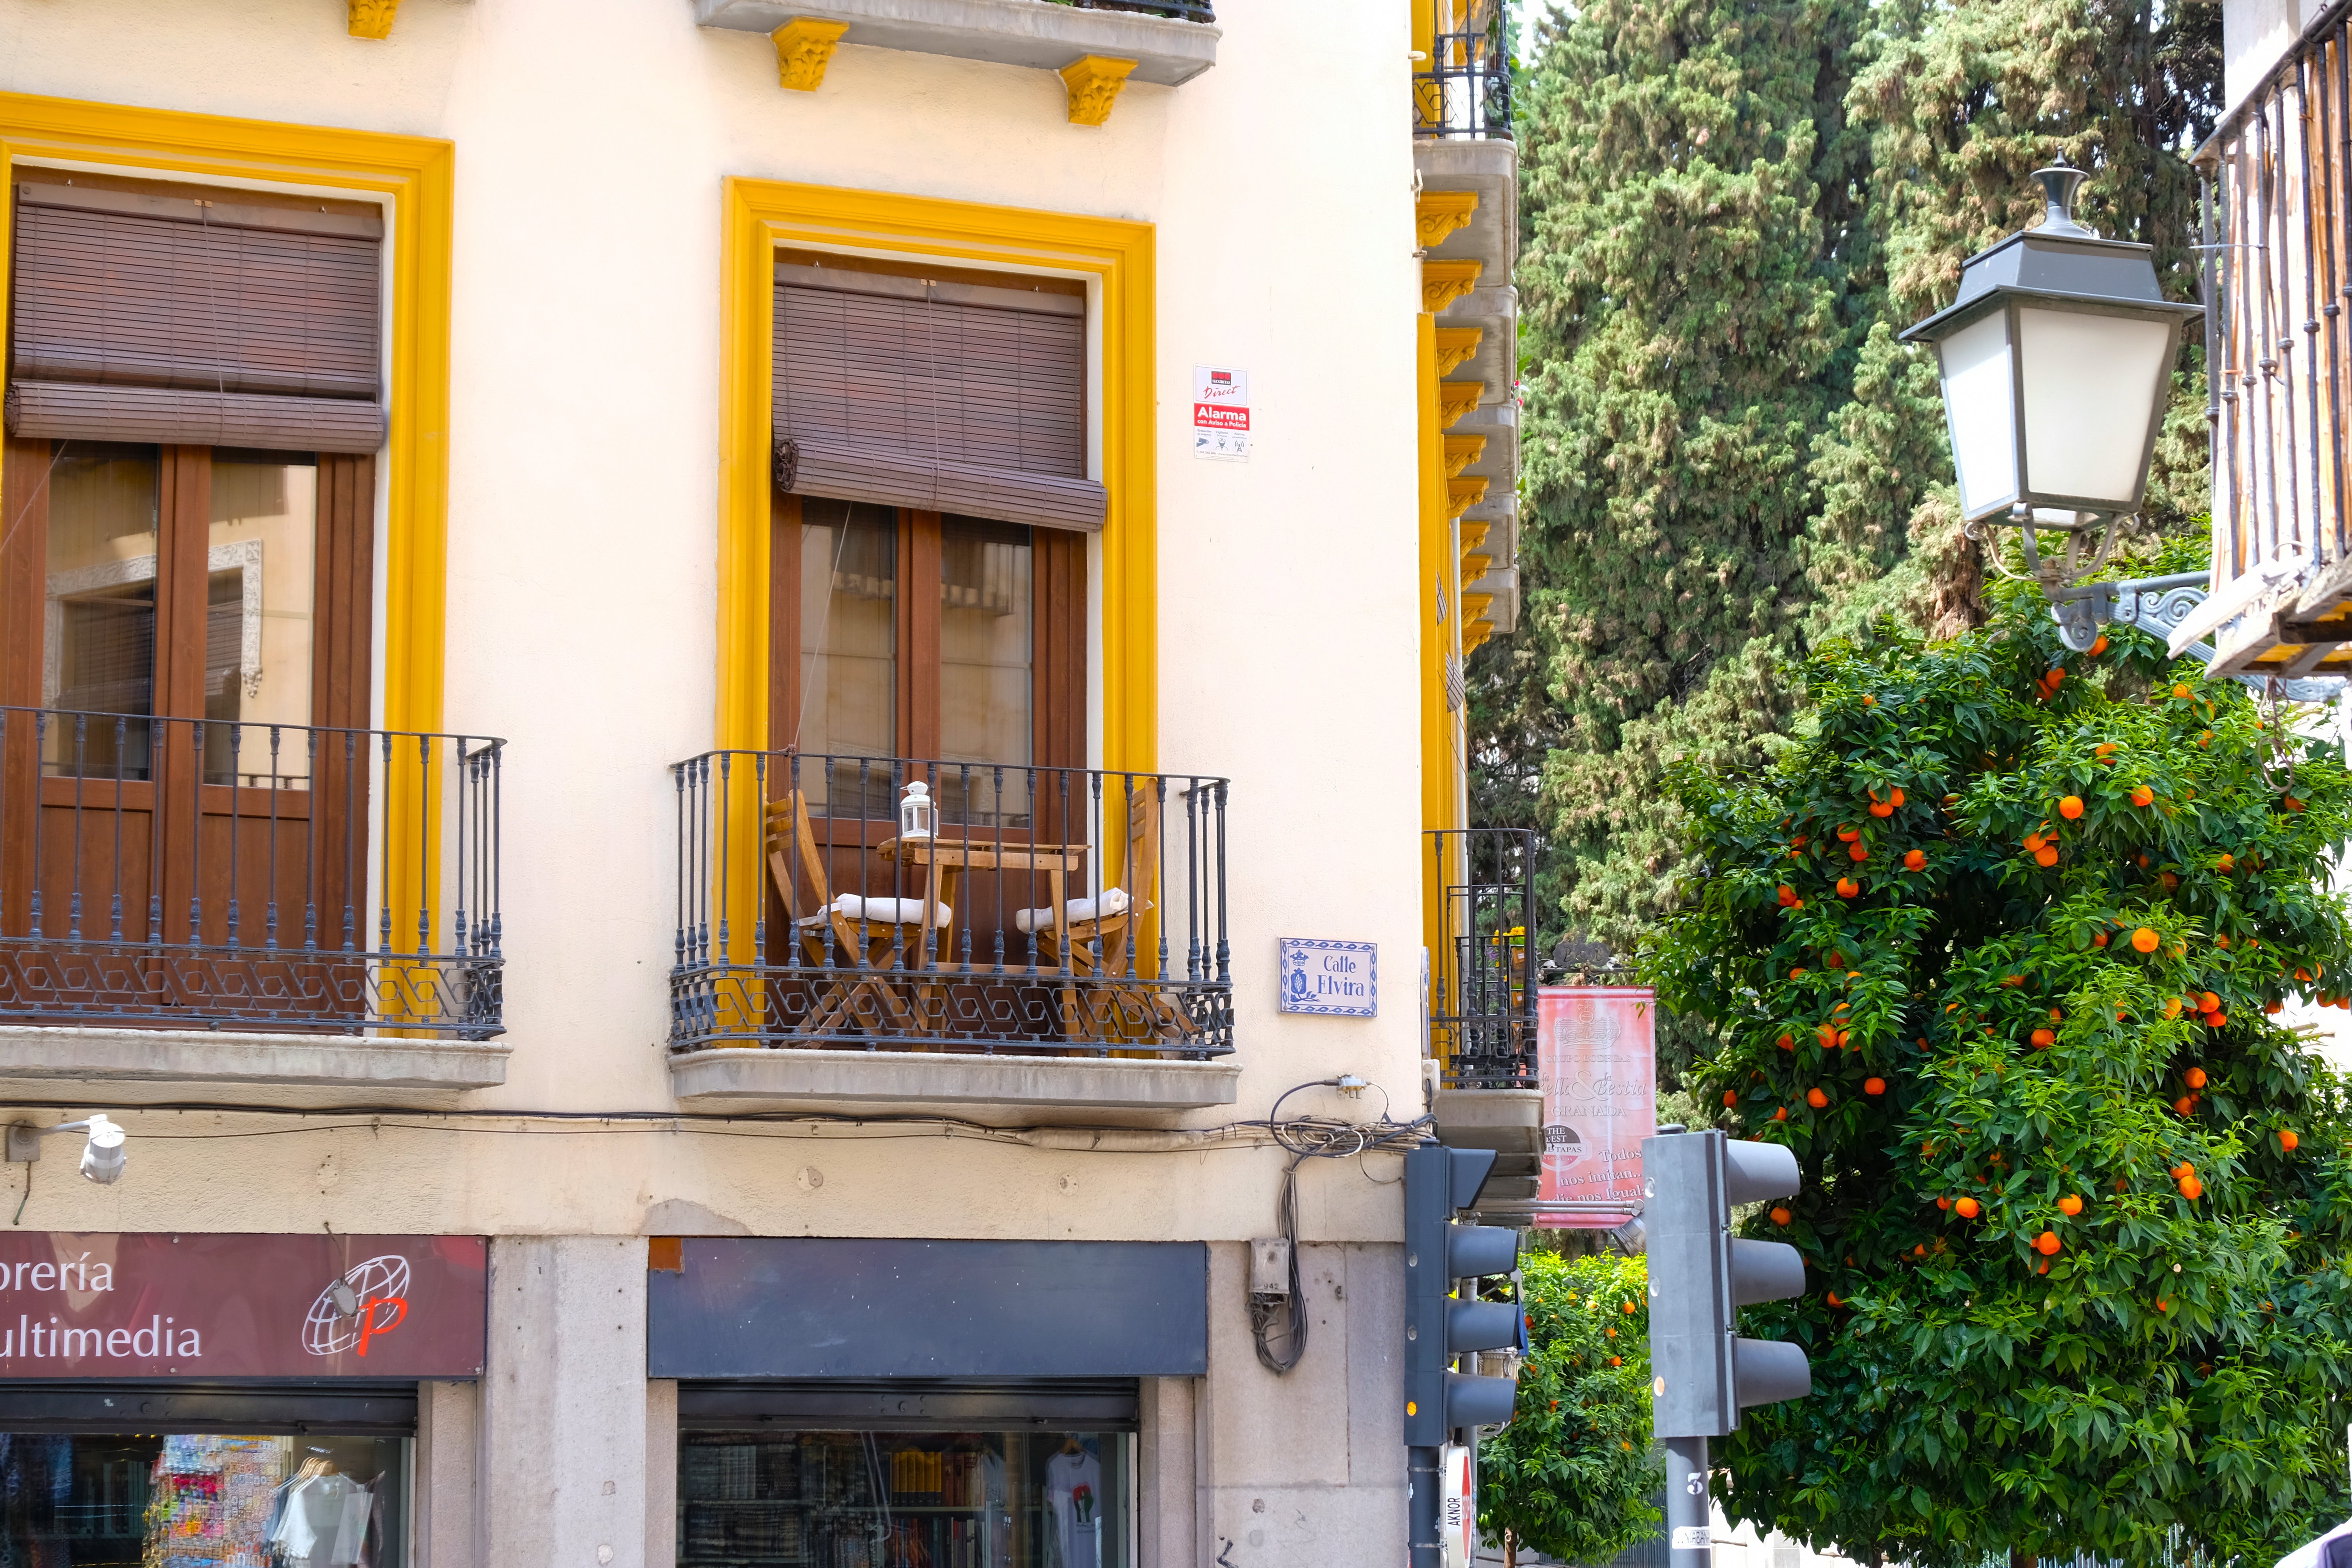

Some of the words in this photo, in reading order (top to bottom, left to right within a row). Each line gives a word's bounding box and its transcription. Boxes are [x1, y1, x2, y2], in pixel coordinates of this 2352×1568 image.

[1203, 385, 1241, 399] Direct
[1197, 406, 1246, 421] Alarma
[1324, 955, 1356, 973] Calle
[1317, 974, 1364, 996] Elvira
[1546, 1055, 1580, 1063] GRUPO
[1583, 1055, 1631, 1063] BODEGAS
[1542, 1072, 1549, 1082] la
[1604, 1072, 1612, 1082] la
[1593, 1079, 1646, 1096] Bestia
[1551, 1105, 1627, 1117] GRANADA
[1598, 1148, 1642, 1162] Todos
[1560, 1176, 1585, 1186] nos
[1577, 1192, 1602, 1202] nos
[1604, 1184, 1644, 1202] Igual
[1447, 1497, 1461, 1526] AKNOR
